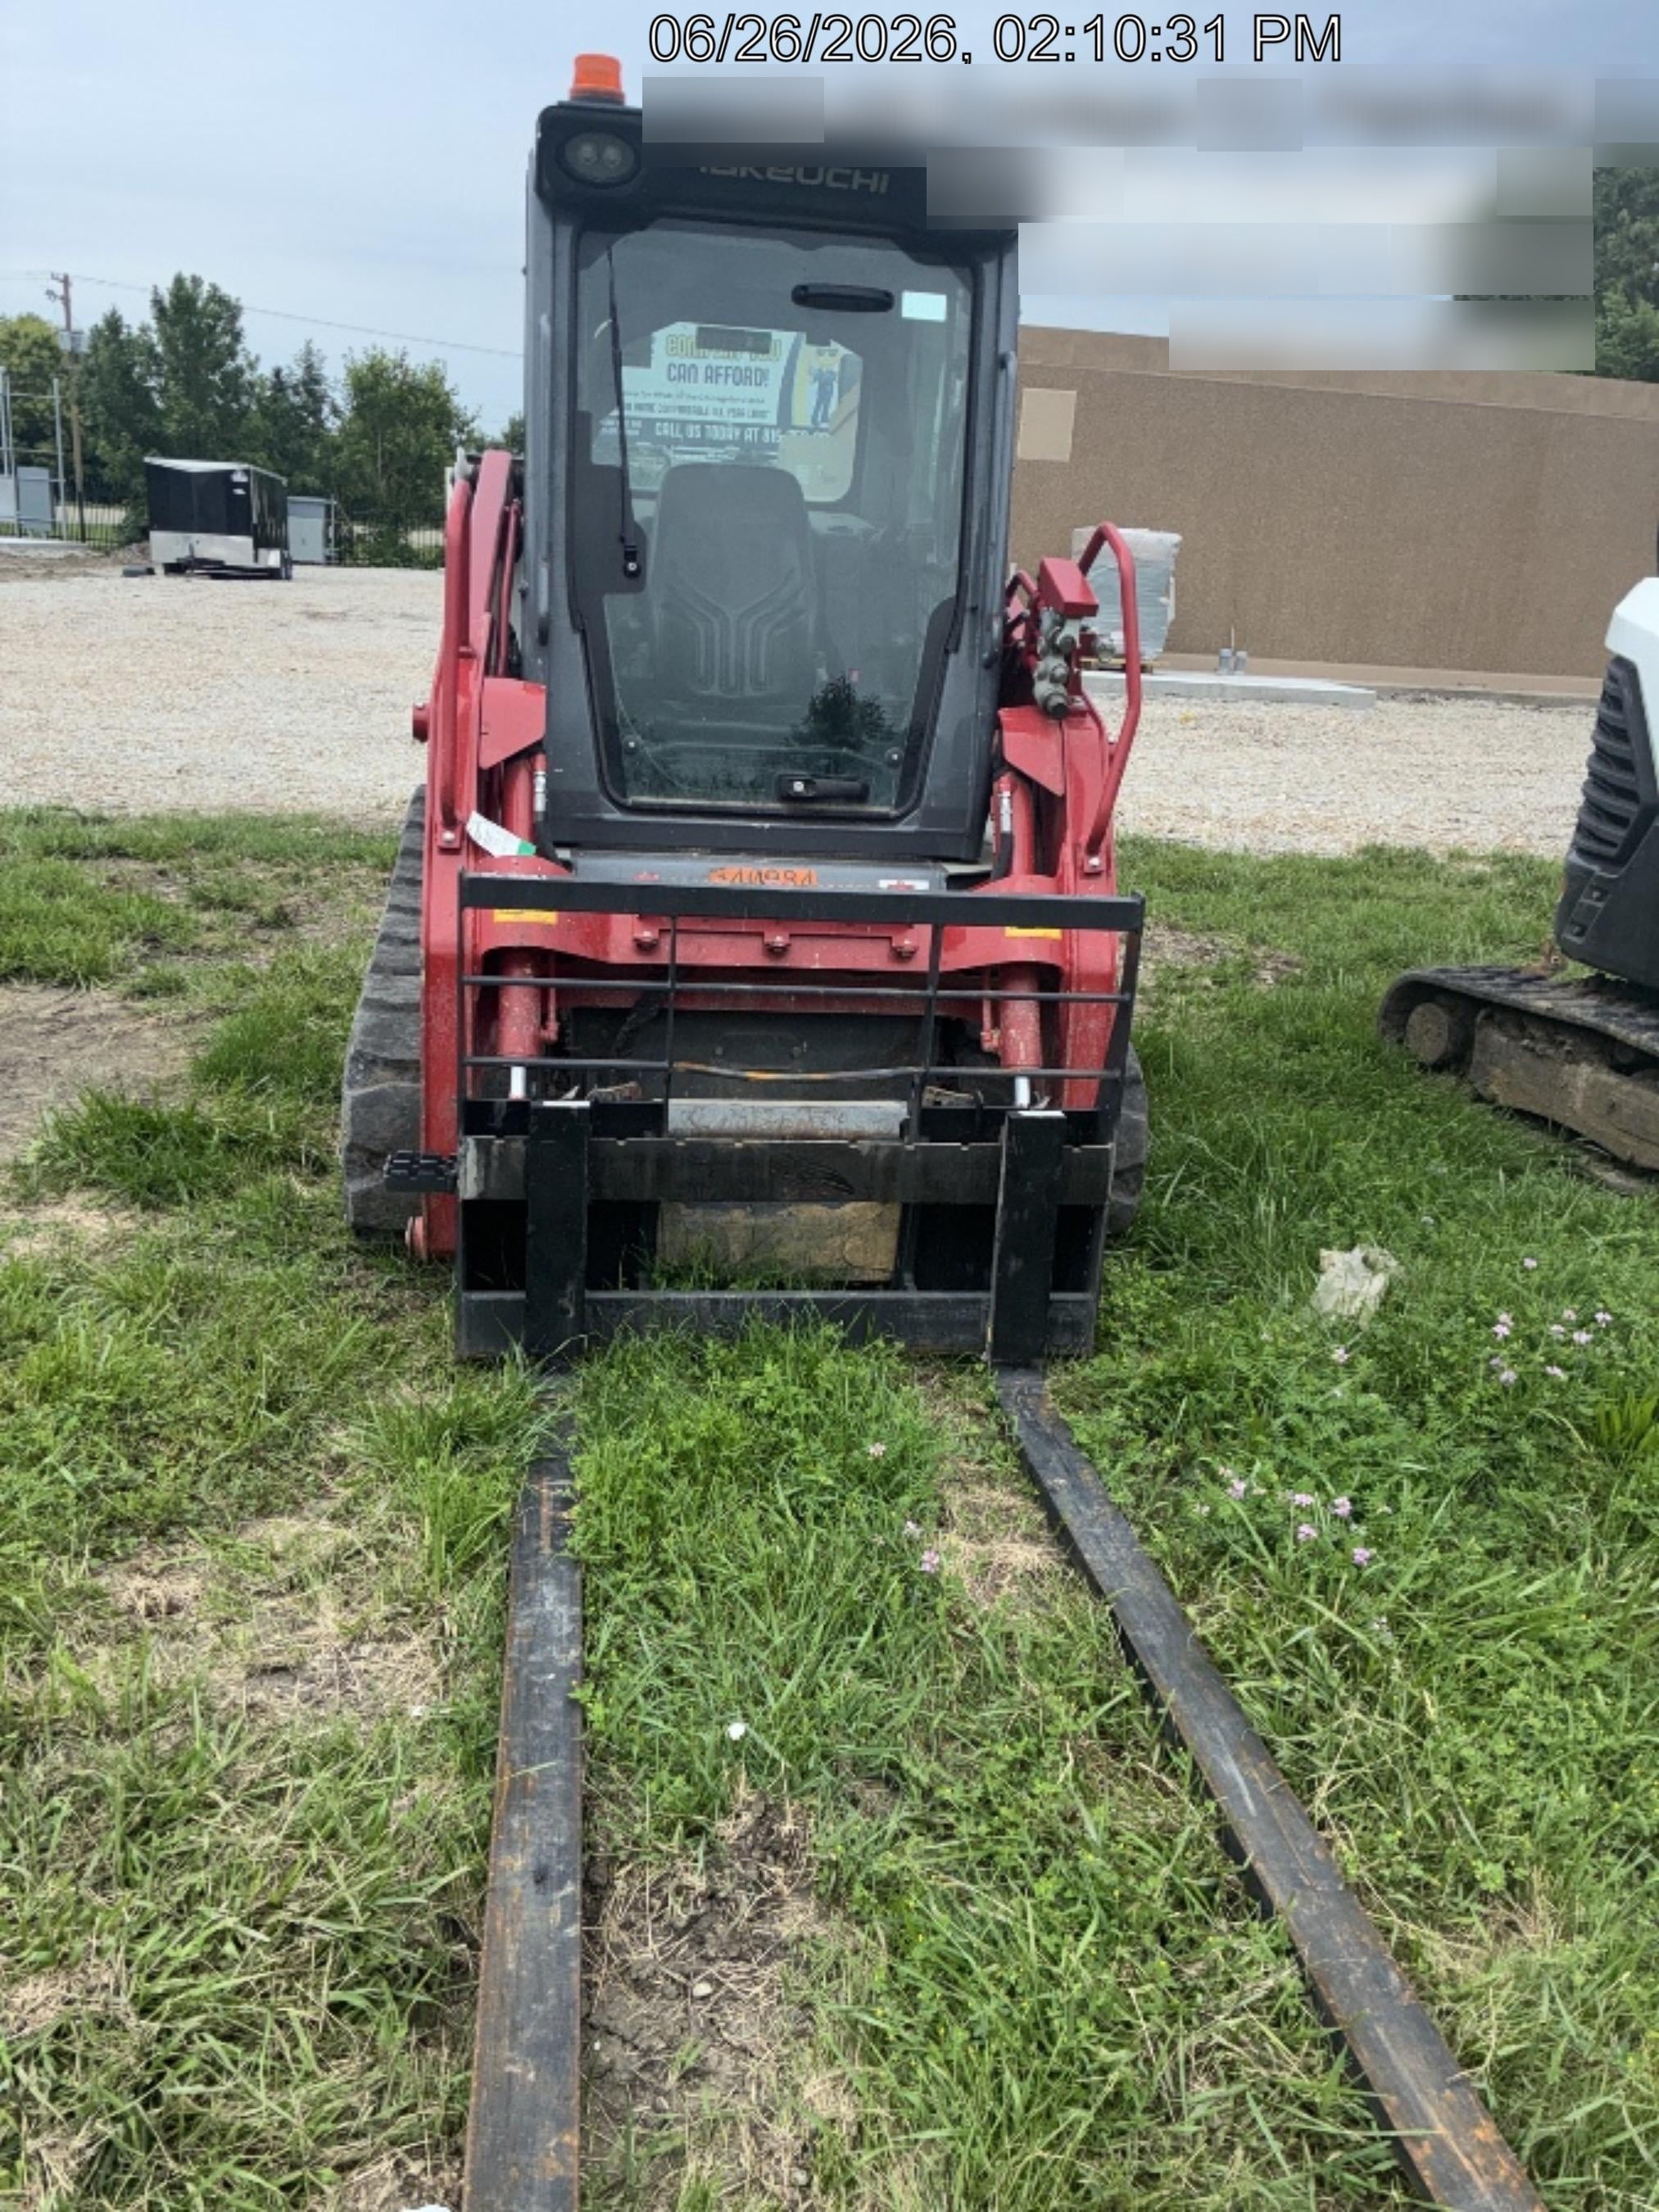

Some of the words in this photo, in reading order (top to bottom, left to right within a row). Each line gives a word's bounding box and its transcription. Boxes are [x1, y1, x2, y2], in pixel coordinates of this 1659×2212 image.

[700, 166, 891, 195] KEUCHI
[668, 363, 698, 384] CAN
[705, 364, 770, 388] AFFORD!
